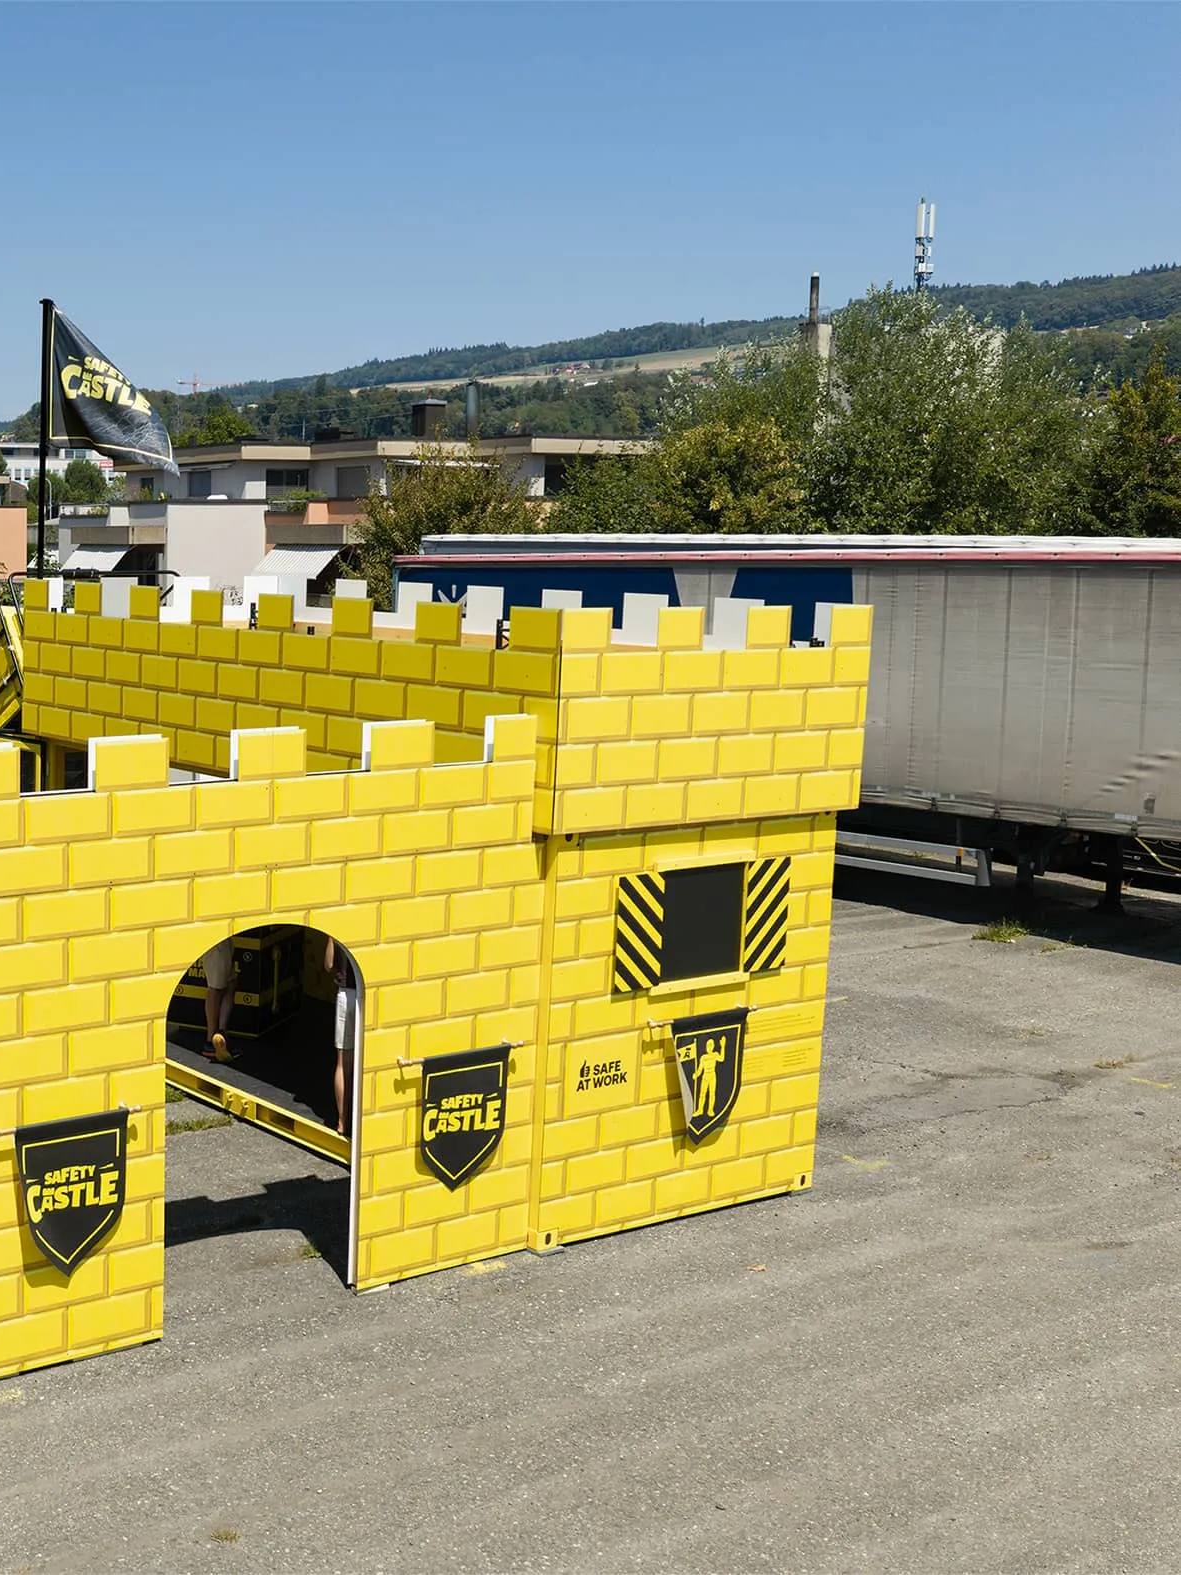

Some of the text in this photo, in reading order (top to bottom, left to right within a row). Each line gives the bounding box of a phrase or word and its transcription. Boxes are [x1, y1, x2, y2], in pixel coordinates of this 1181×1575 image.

[61, 364, 152, 416] CASTLE
[593, 1060, 621, 1076] SAFE
[576, 1072, 627, 1092] AT WORK
[441, 1094, 484, 1109] SAFETY
[423, 1099, 502, 1142] CASTLE
[44, 1165, 96, 1185] SAFETY
[27, 1171, 119, 1224] CASTLE
